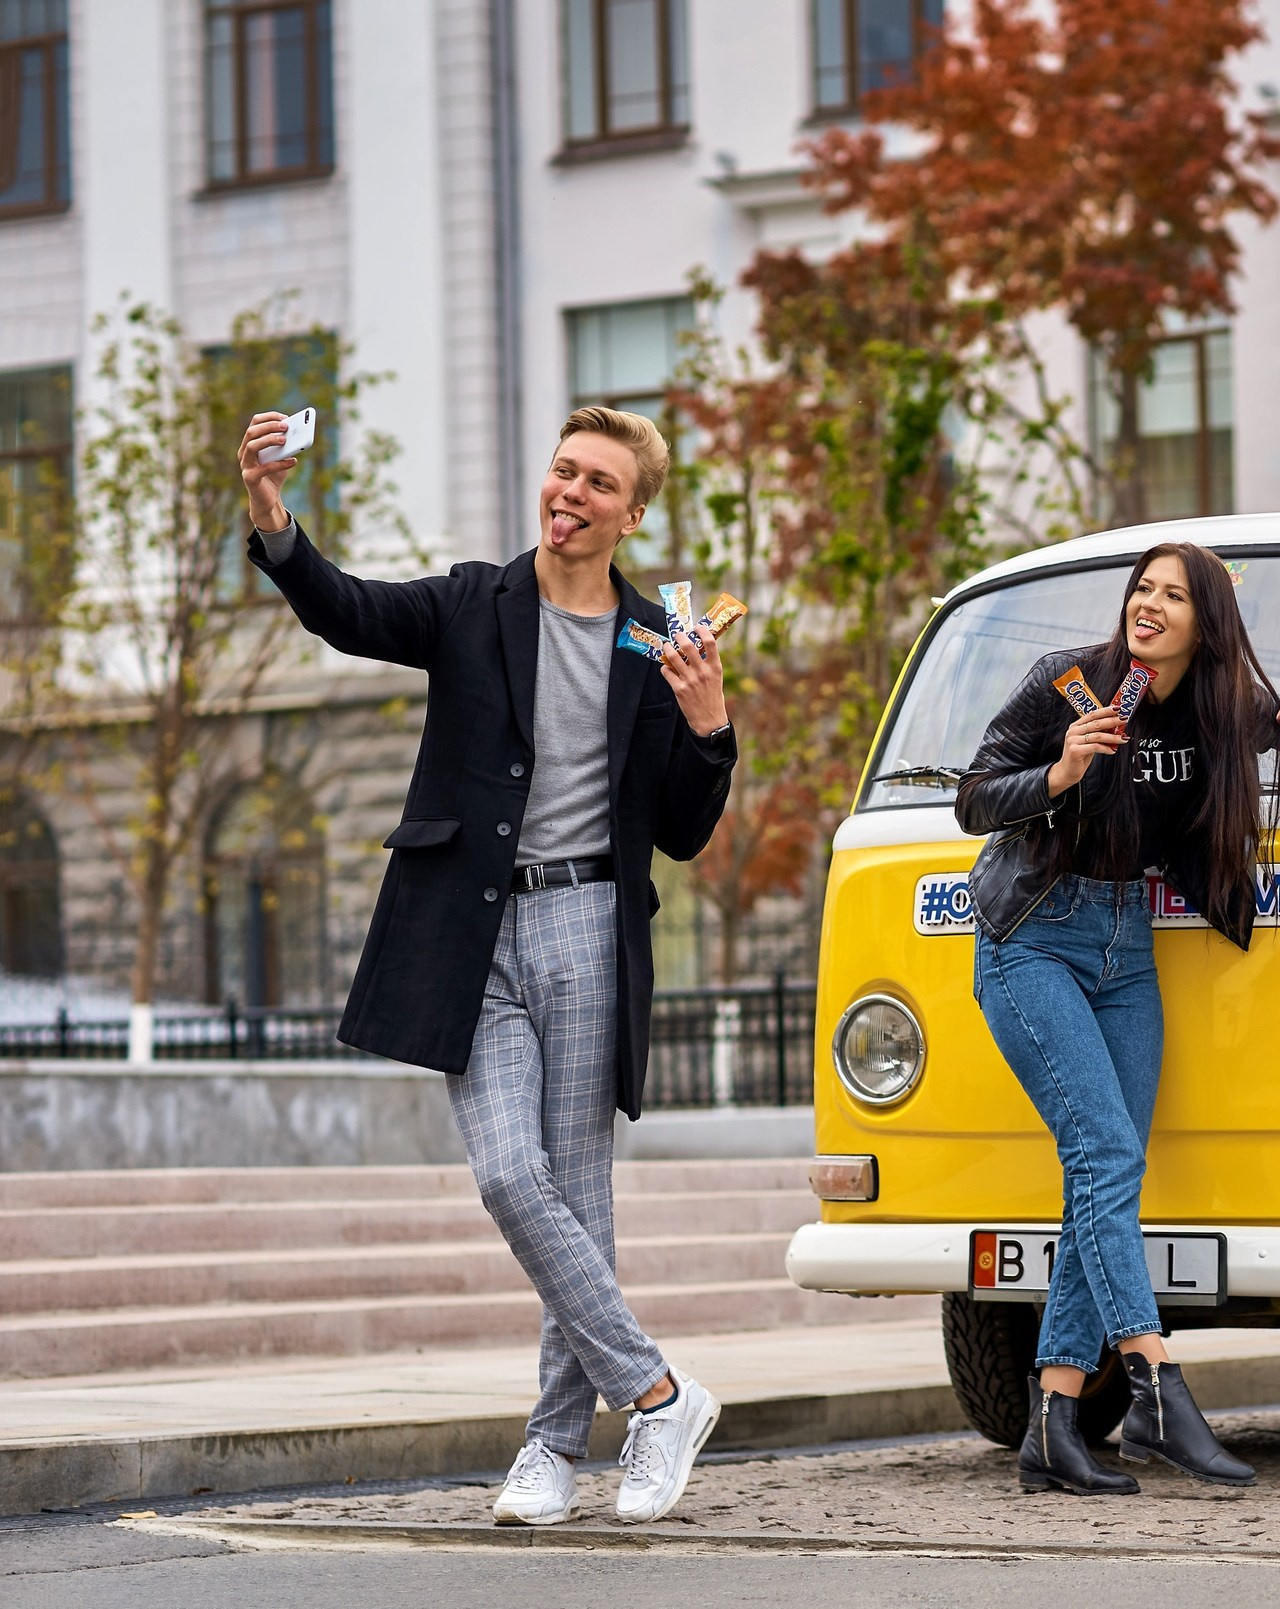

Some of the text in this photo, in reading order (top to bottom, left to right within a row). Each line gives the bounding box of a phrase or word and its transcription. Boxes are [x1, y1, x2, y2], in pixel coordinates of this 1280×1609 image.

[1066, 681, 1098, 714] COR
[1067, 696, 1083, 712] BIG
[1132, 747, 1195, 783] GUE
